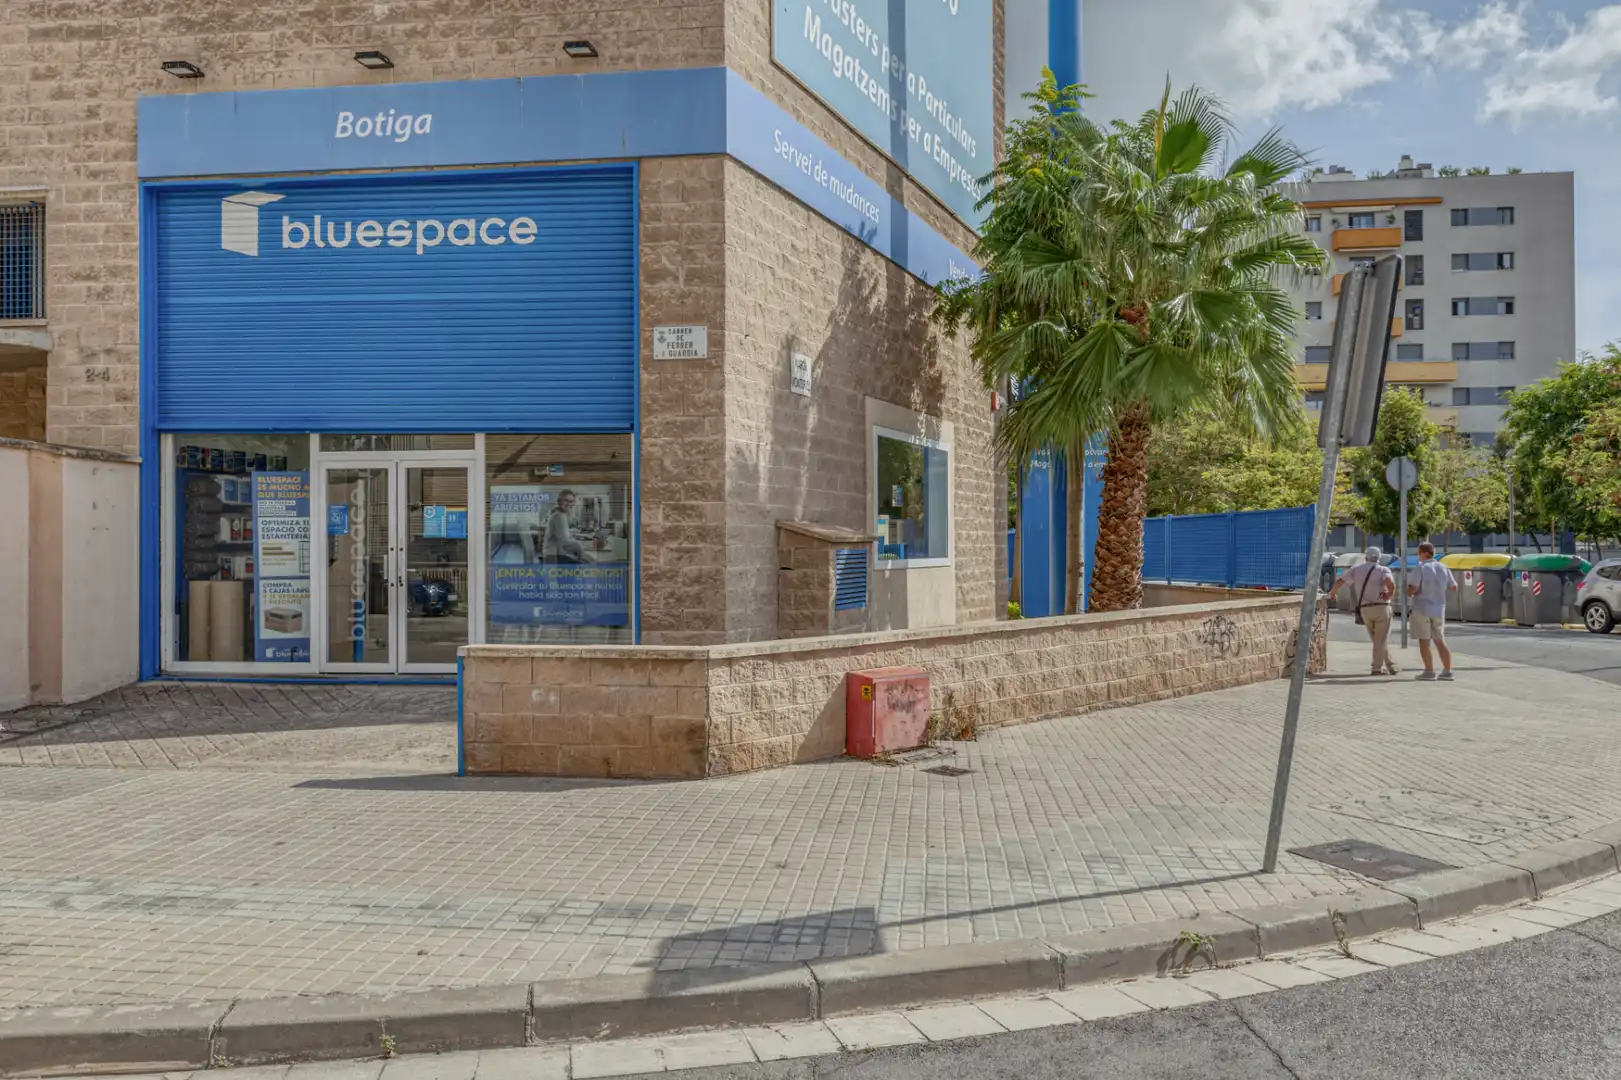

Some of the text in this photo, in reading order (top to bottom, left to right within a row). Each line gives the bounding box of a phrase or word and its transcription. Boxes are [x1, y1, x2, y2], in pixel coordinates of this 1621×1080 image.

[823, 0, 977, 158] asters per a Particulars
[804, 5, 982, 201] Magatzems per a Empreses
[334, 109, 433, 143] Botiga
[774, 129, 880, 224] Servei de mudances
[282, 214, 538, 255] bluespace
[667, 341, 693, 349] FERRER
[668, 327, 692, 335] CARRER
[494, 493, 506, 502] YA
[348, 488, 368, 640] bluespace
[537, 568, 543, 577] Y
